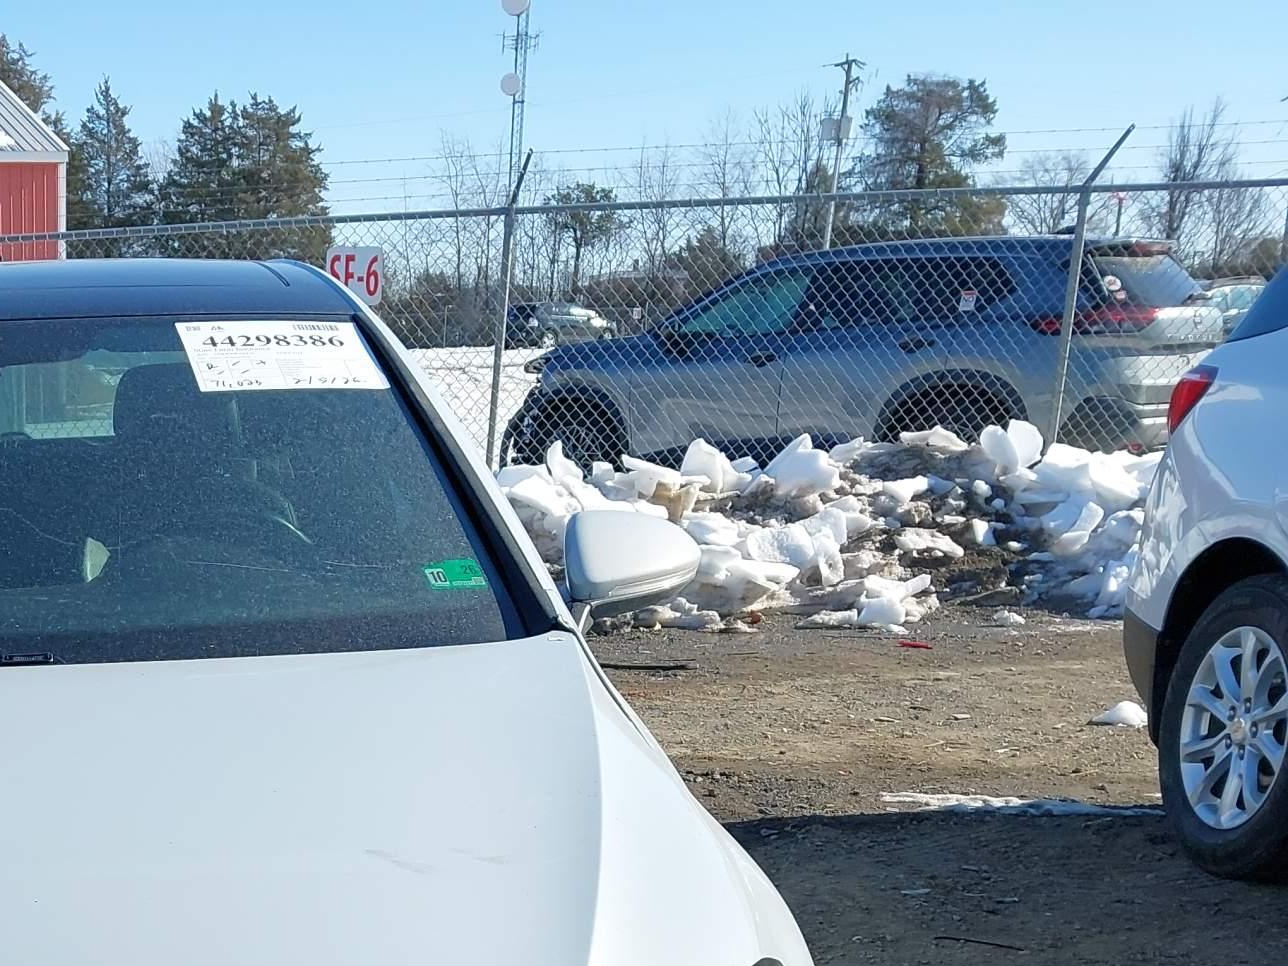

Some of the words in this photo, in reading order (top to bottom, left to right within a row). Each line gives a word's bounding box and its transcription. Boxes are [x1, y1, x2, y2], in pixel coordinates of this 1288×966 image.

[330, 254, 379, 297] SF-6
[202, 334, 344, 348] 44298386
[428, 570, 448, 583] 10
